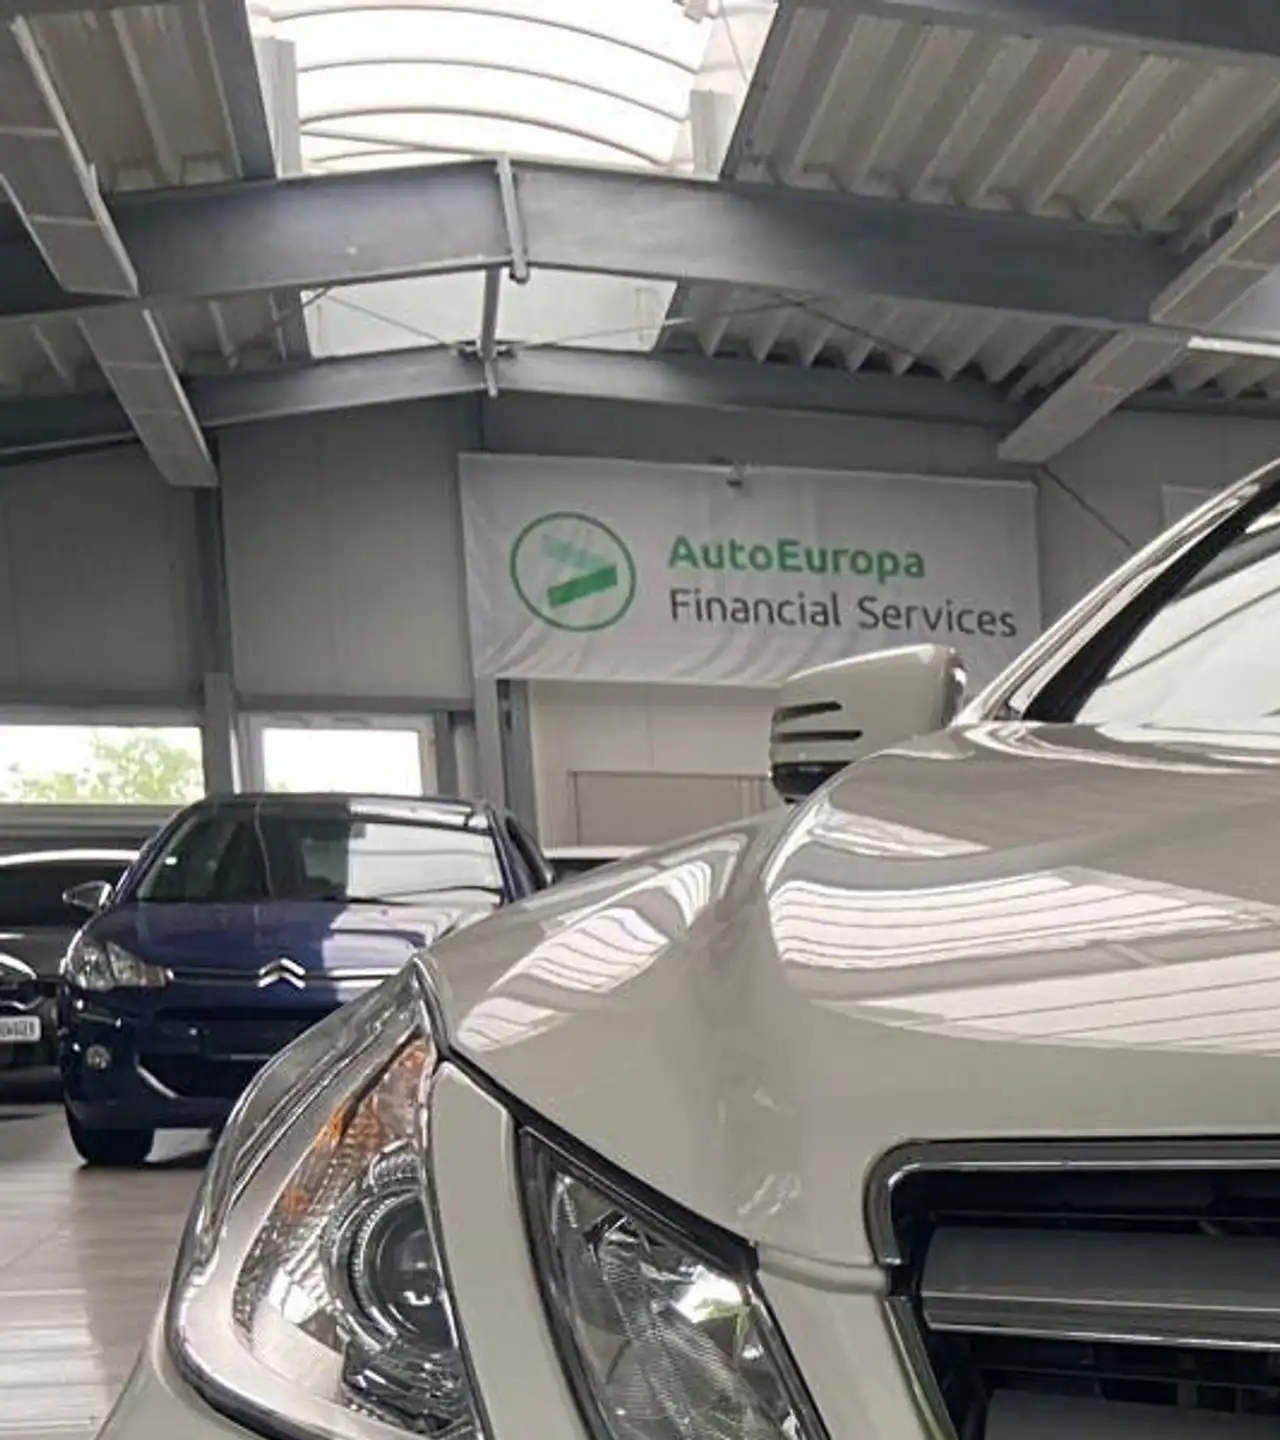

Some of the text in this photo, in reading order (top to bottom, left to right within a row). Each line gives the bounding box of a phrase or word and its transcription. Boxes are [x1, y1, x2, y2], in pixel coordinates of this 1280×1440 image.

[667, 535, 925, 580] AutoEuropa
[671, 589, 1018, 638] Financial Services
